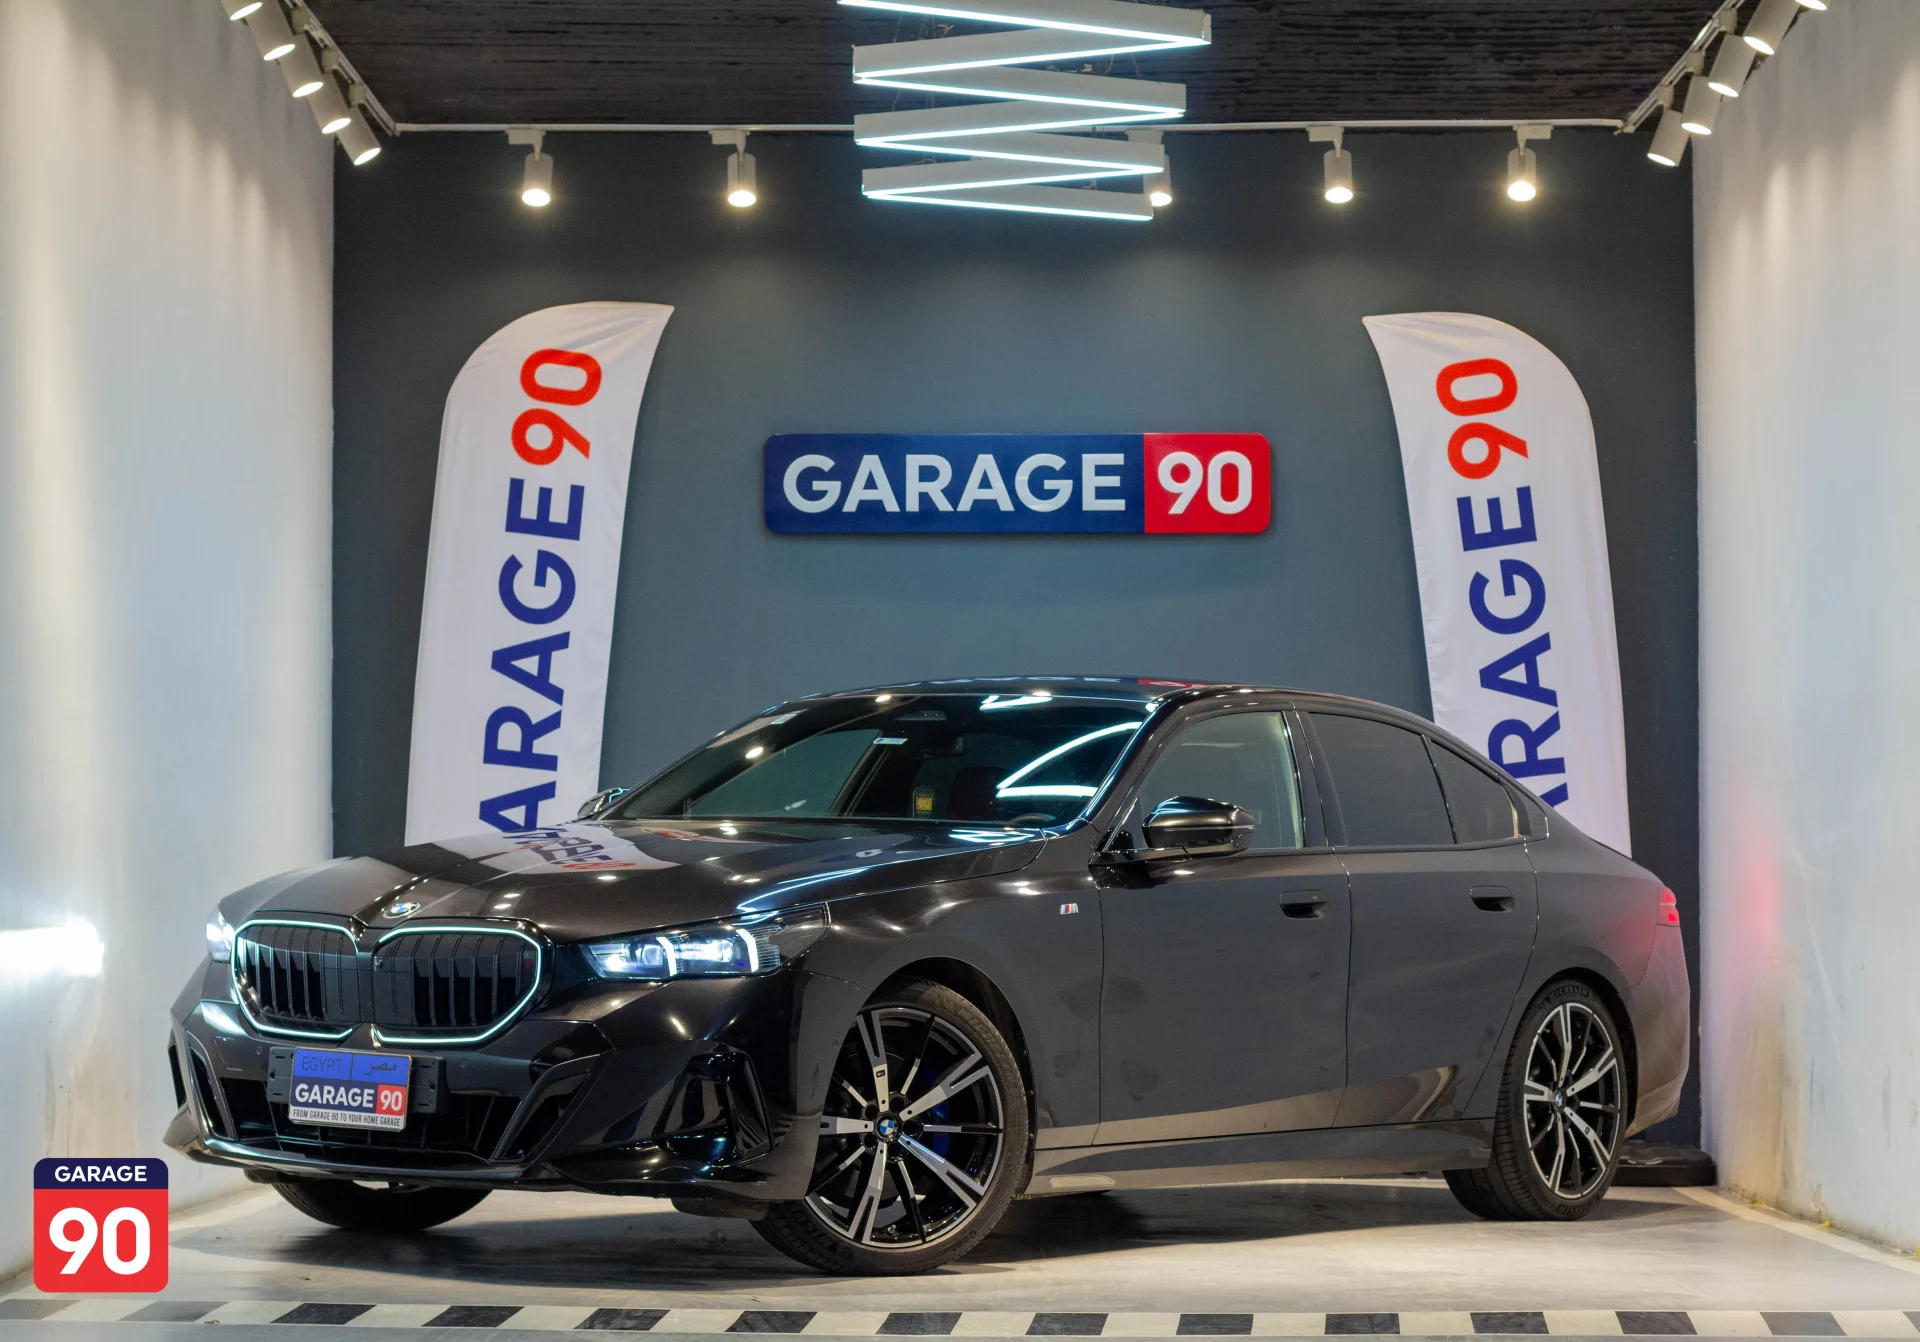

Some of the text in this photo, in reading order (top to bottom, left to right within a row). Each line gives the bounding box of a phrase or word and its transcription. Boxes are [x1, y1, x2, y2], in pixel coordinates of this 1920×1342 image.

[782, 450, 1253, 514] GARAGE 90
[479, 348, 602, 833] ARAGE 90
[1435, 358, 1569, 807] RAGE 90
[301, 1056, 343, 1073] EGYPT
[363, 1061, 397, 1076] مصر
[295, 1083, 403, 1112] GARAGE 90
[293, 1109, 401, 1127] FROM GARAGE 90 TO YOUR HOME GARAGE
